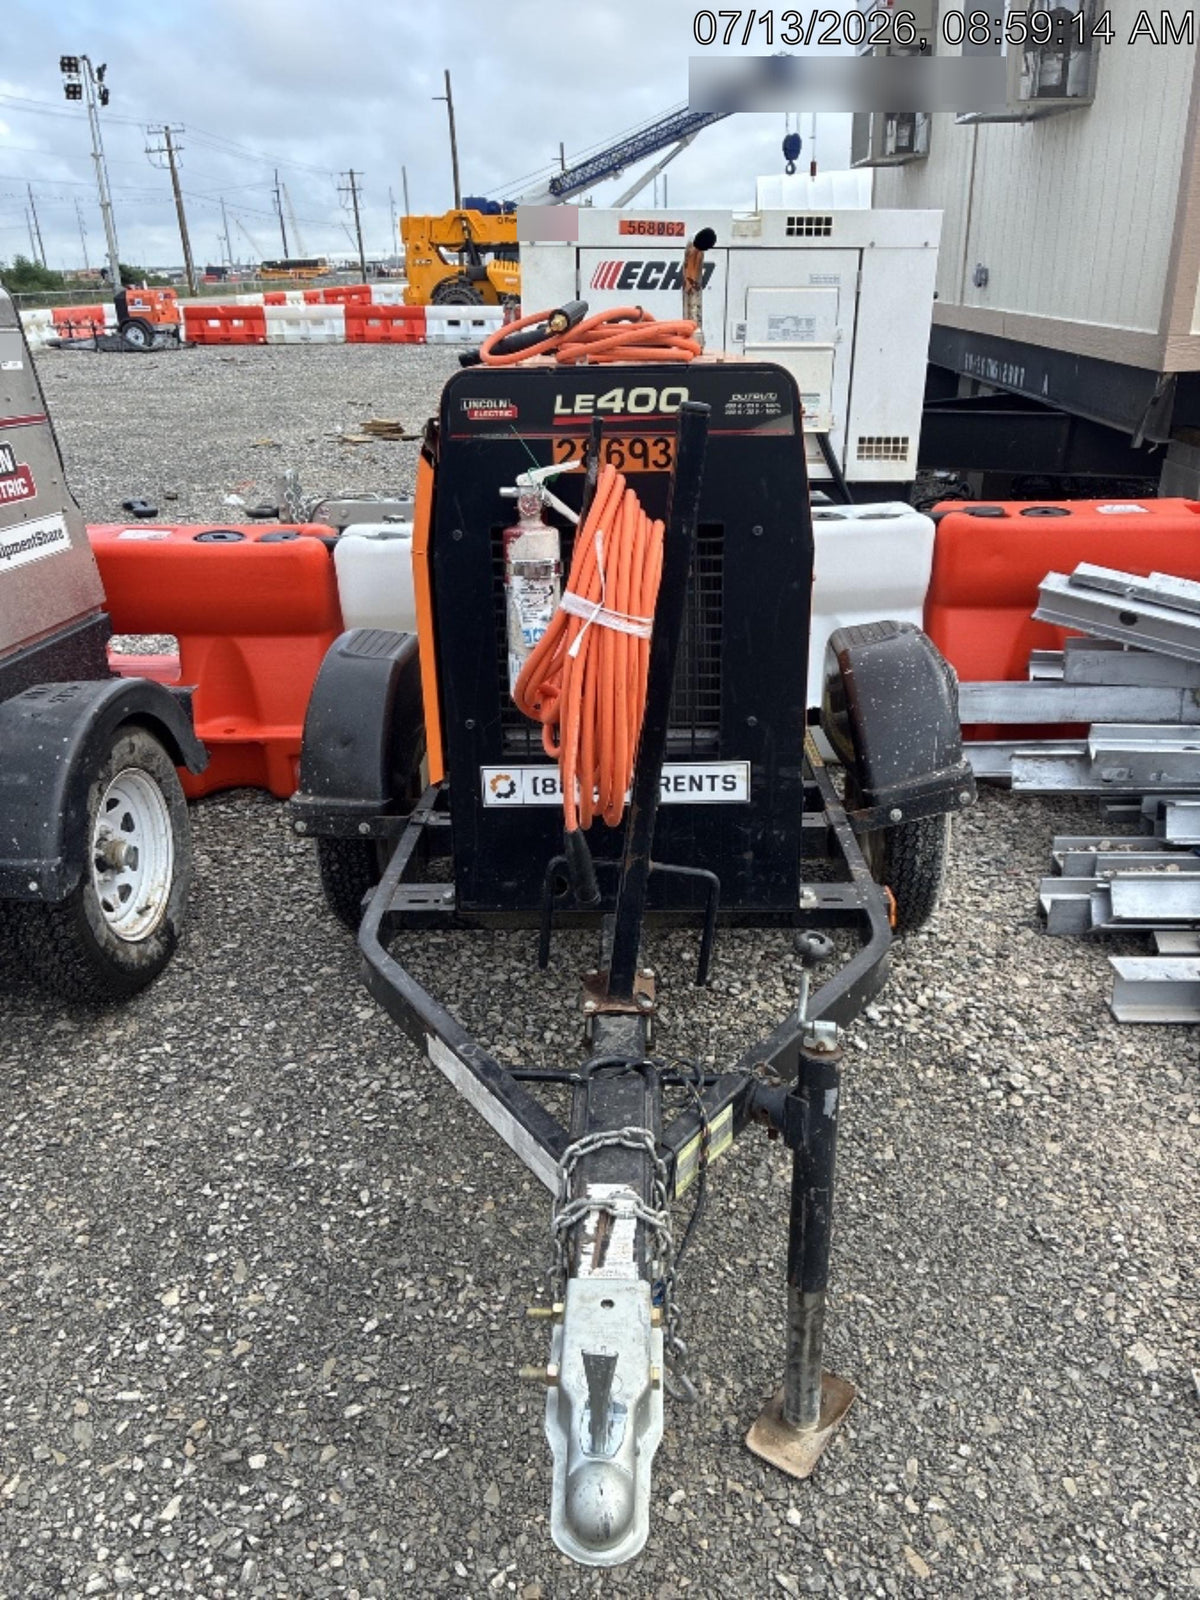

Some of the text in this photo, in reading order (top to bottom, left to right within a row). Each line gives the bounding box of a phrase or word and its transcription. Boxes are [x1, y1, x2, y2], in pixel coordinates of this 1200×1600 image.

[627, 221, 685, 236] 568062
[463, 399, 508, 410] LINCOLN
[554, 387, 689, 414] LE400
[473, 410, 513, 418] ELECTRIC
